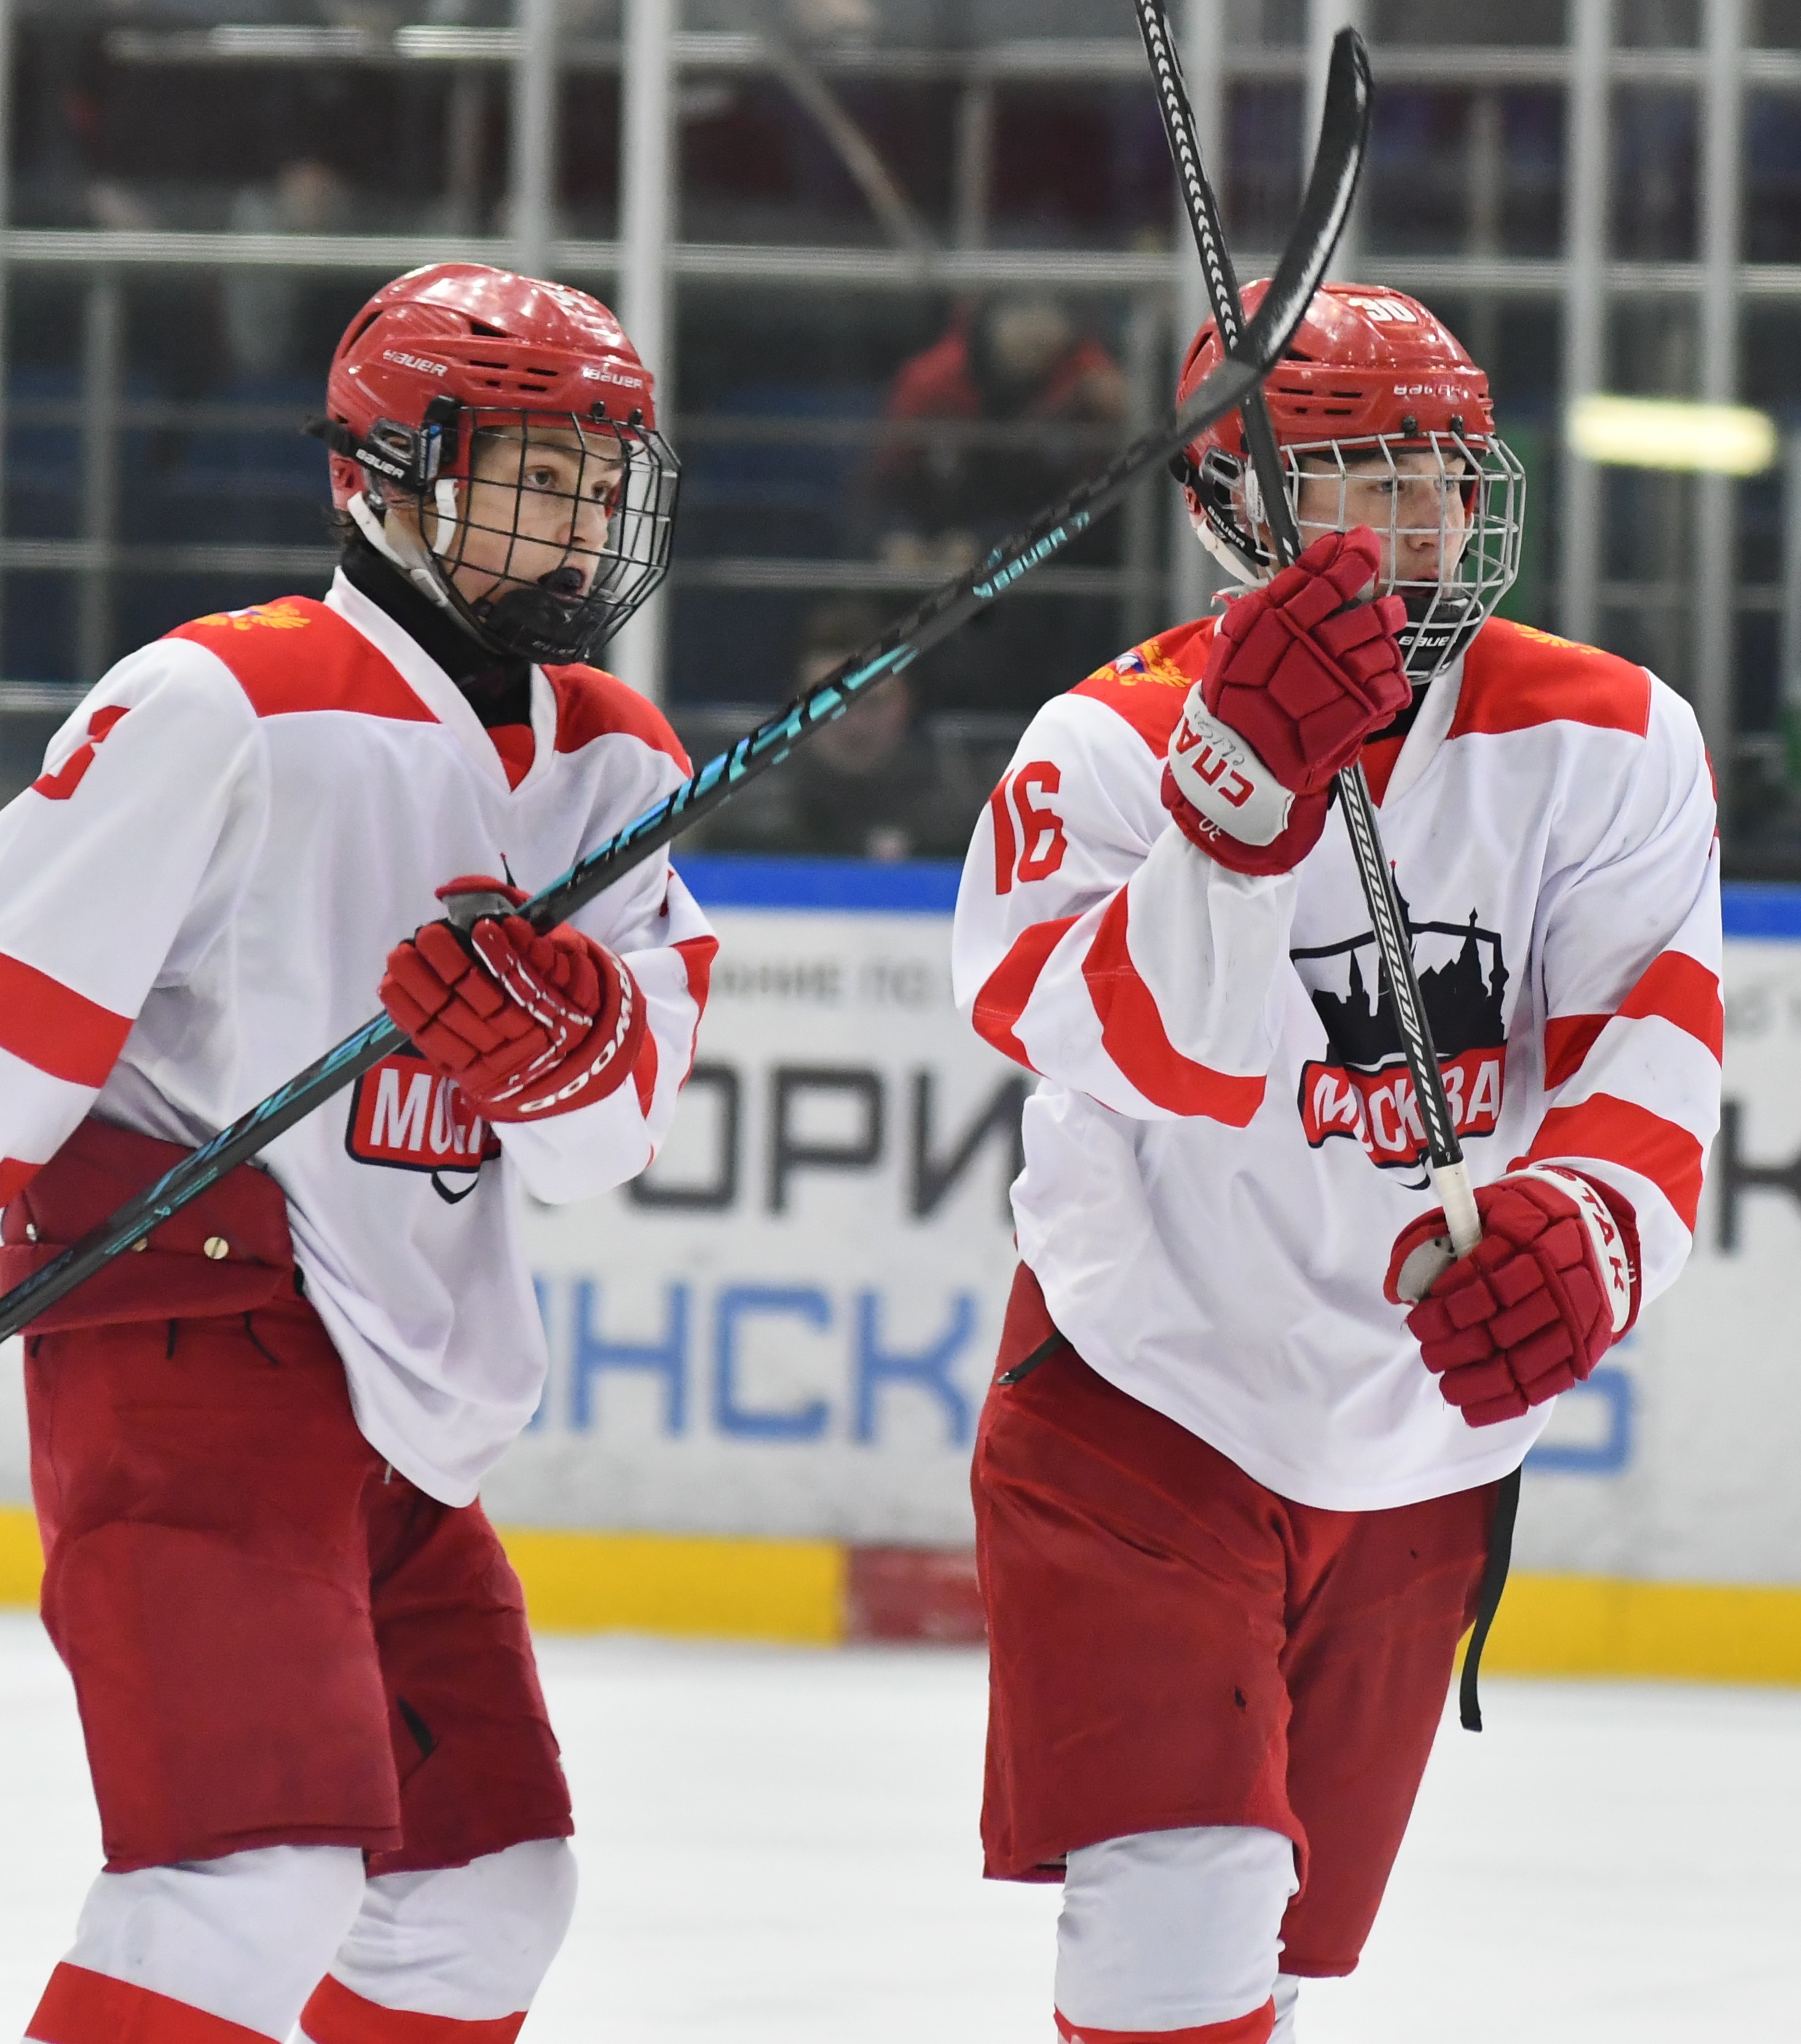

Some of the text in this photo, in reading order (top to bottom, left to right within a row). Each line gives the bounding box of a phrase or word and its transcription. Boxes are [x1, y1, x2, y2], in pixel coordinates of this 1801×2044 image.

[1349, 297, 1416, 322] 30
[356, 448, 405, 479] BAUER
[1398, 636, 1453, 647] BAUE
[990, 761, 1067, 895] 16
[620, 1061, 1023, 1223] ОРИ
[534, 1270, 984, 1447] НСК
